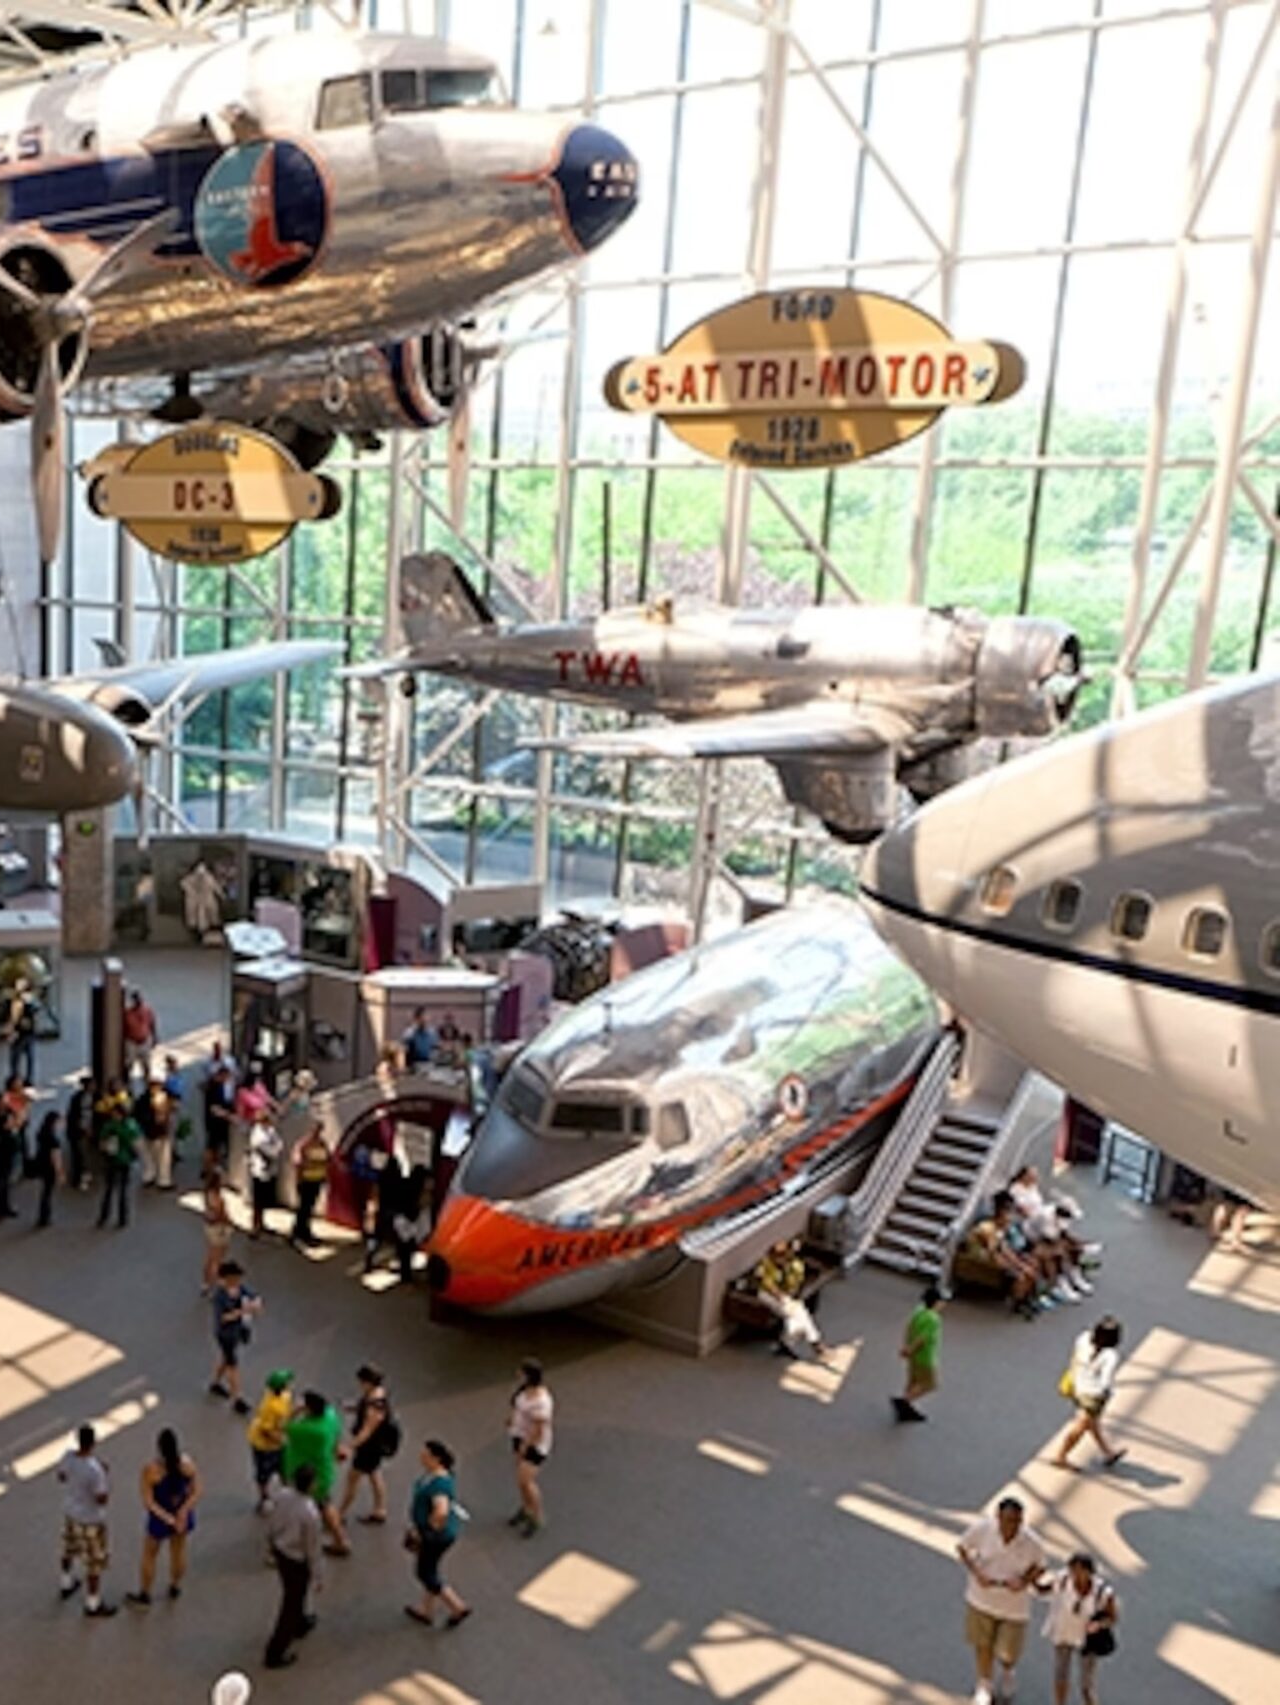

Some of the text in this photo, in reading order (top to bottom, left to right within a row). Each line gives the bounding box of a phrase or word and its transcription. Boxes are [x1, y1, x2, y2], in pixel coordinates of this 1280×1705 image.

[772, 295, 836, 322] FORD
[642, 353, 970, 403] 5-AT TRI-MOTOR
[173, 481, 234, 511] DC-3
[554, 651, 643, 685] TWA
[518, 1228, 654, 1269] AMERICAN
